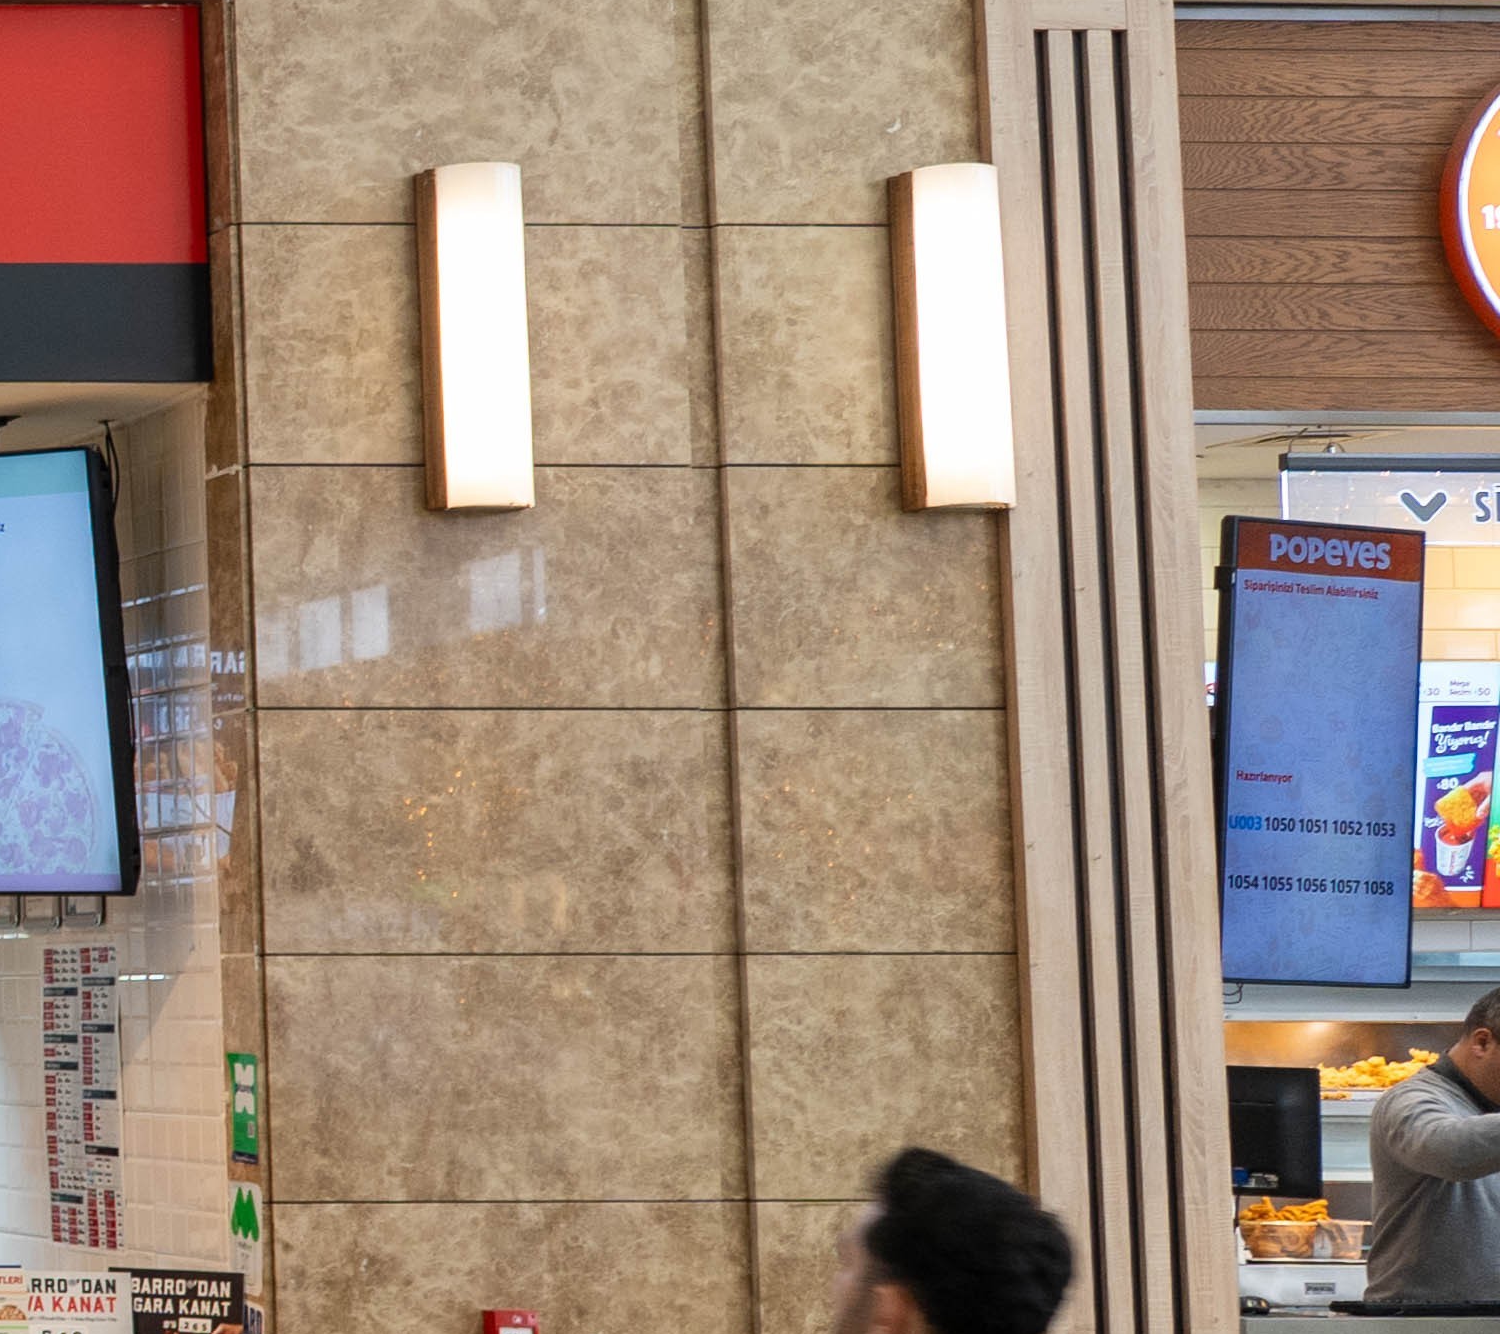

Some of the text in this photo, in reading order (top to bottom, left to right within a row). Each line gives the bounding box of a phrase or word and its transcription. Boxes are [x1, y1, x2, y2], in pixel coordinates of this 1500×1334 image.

[1244, 579, 1294, 597] Siparişinizi
[1296, 582, 1324, 597] Teslim
[1228, 815, 1396, 837] U003 1050 1051 1052 1053
[1227, 875, 1394, 896] 1054 1055 1056 1057 1058
[52, 1296, 117, 1313] KANAT
[133, 1297, 231, 1317] GARA KANAT
